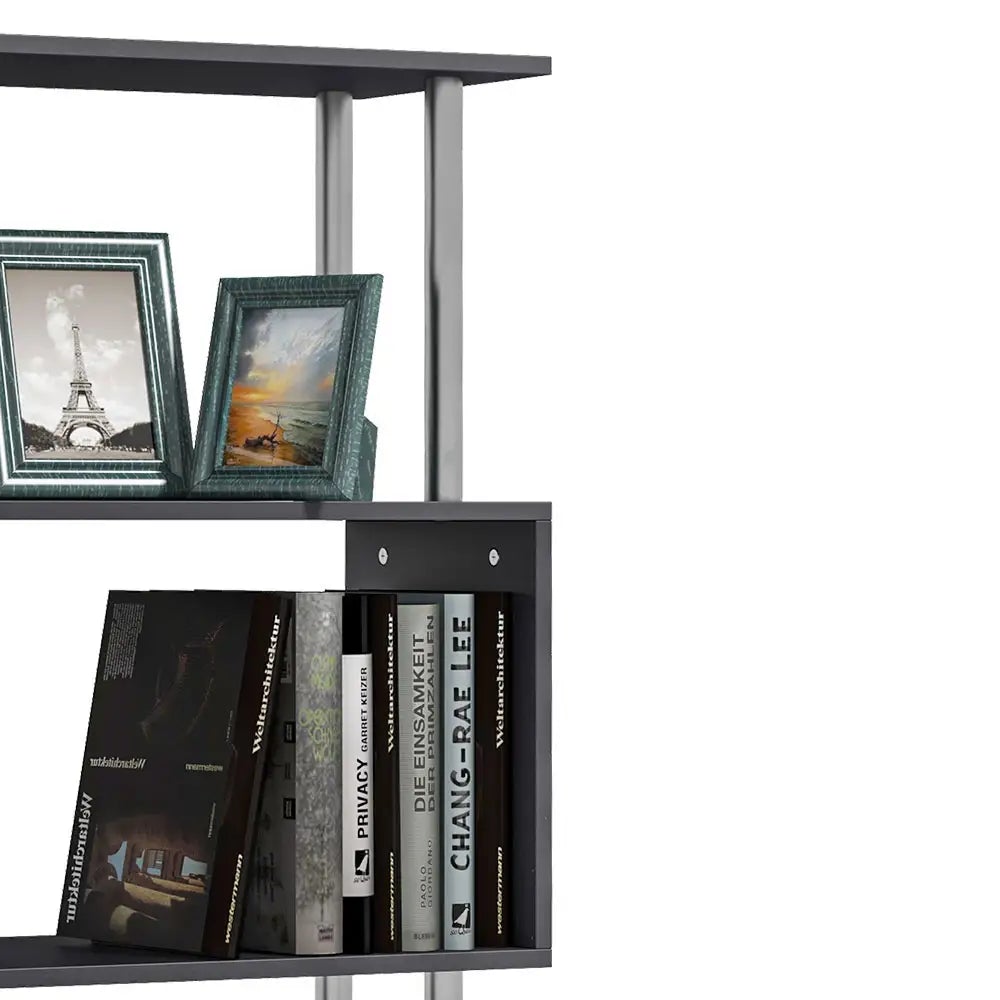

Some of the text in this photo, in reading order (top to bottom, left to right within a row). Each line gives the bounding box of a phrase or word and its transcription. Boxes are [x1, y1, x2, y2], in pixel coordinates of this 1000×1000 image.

[252, 614, 281, 754] Weltarchitektur
[360, 666, 369, 752] GARRET KEIZER
[412, 633, 426, 812] DIE EINSAMKEIT
[426, 615, 436, 812] DER PRIMZAHLEN
[450, 616, 472, 871] CHANG-RAE LEE
[495, 611, 504, 749] Weltarchitektur
[356, 758, 369, 839] PRIVACY
[225, 853, 244, 944] westermann
